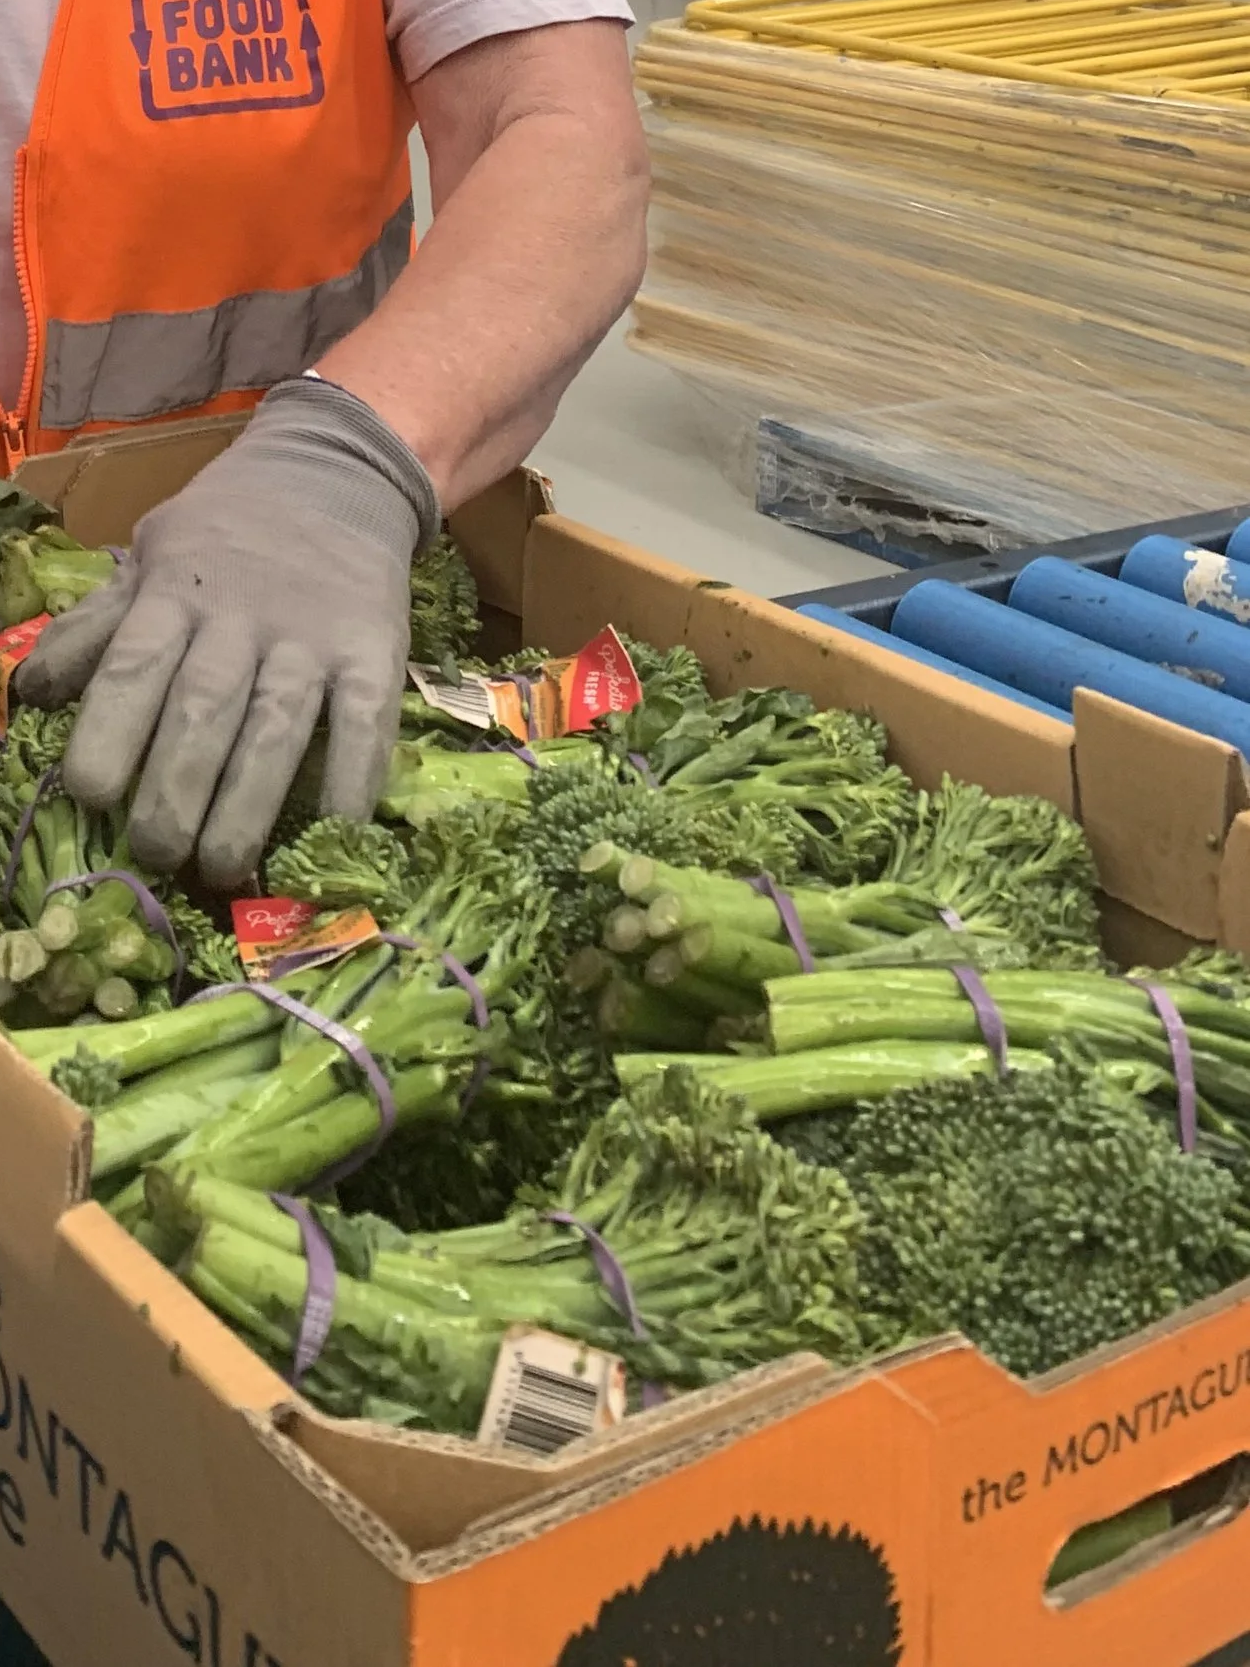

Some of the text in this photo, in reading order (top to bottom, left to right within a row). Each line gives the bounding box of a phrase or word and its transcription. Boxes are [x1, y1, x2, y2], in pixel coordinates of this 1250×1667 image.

[166, 37, 294, 92] BANK
[597, 643, 630, 712] Perfectio
[961, 1470, 1027, 1523] the
